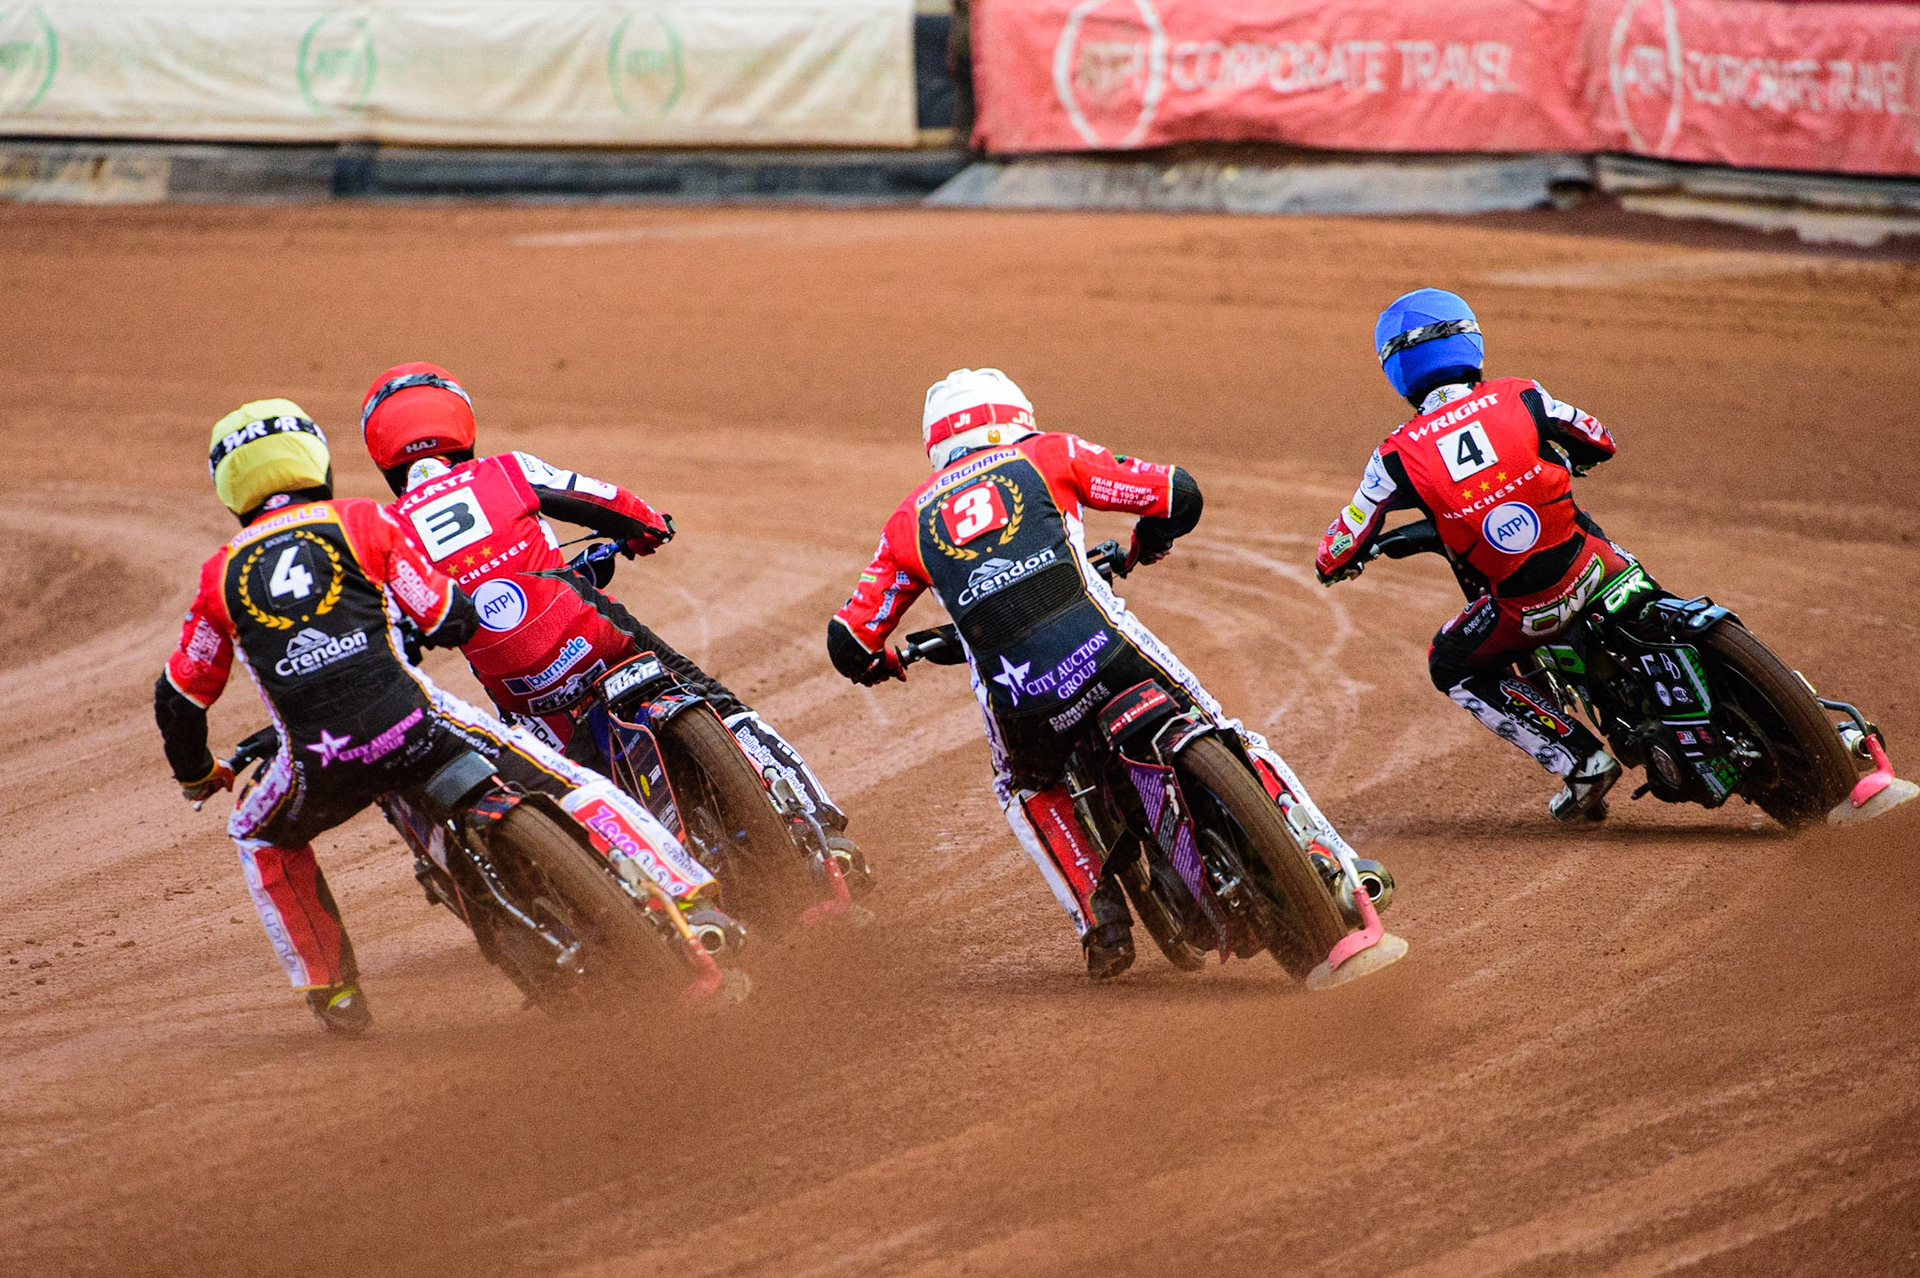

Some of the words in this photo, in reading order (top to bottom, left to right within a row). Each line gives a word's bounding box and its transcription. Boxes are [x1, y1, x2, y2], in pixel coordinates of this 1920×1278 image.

[1407, 393, 1498, 441] WRIGHT
[405, 437, 437, 453] HAJ
[1456, 431, 1484, 467] 4
[398, 469, 475, 514] KURTZ
[1090, 492, 1110, 503] TONI
[1091, 476, 1113, 489] FRAN
[1091, 484, 1118, 498] BRUCE
[1444, 464, 1542, 520] MANCHESTER
[232, 507, 328, 550] NICHOLLS
[425, 502, 475, 546] 3
[952, 484, 995, 540] 3
[1497, 513, 1529, 542] ATPI
[269, 545, 313, 599] 4
[459, 540, 528, 585] CHESTER
[957, 548, 1056, 606] Crendon
[482, 591, 515, 619] ATPI
[1603, 571, 1654, 612] CWR
[275, 631, 368, 677] Crendon
[526, 636, 586, 688] burnside
[1025, 671, 1058, 697] CITY
[1054, 630, 1109, 680] AUCTION
[1056, 660, 1098, 701] GROUP
[1049, 681, 1105, 728] COMPLETE
[586, 805, 640, 858] Zero
